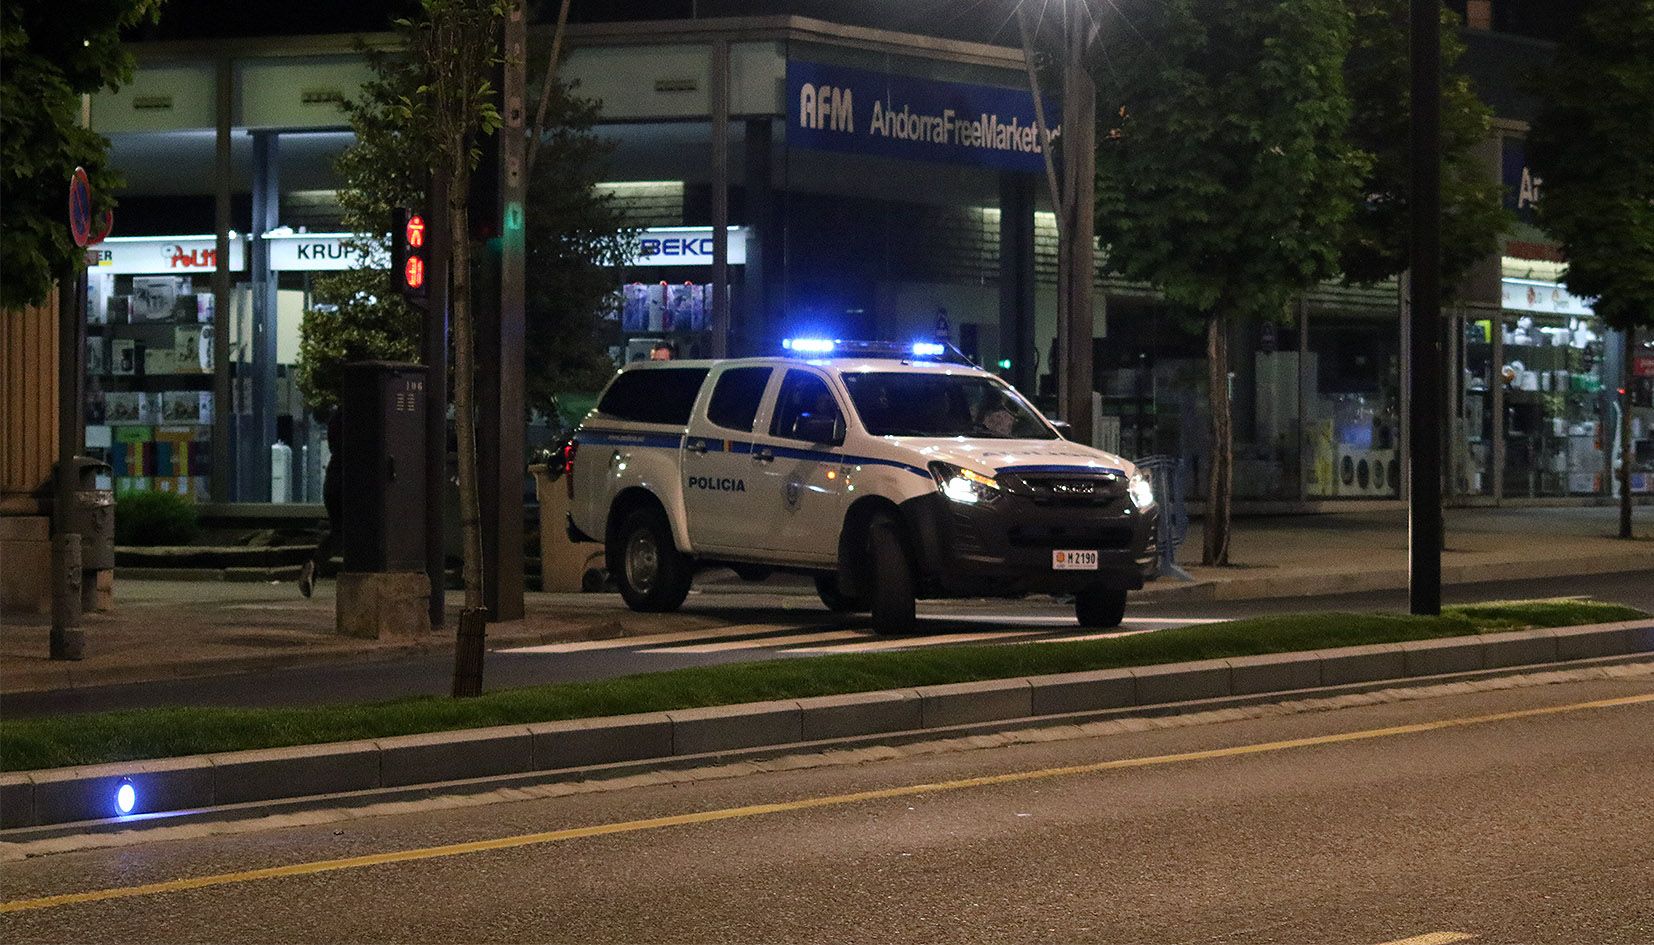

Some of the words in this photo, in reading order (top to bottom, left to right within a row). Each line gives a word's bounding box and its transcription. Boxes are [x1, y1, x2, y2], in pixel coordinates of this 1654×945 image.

[800, 82, 854, 133] AFM
[688, 477, 746, 492] POLICIA
[1075, 552, 1096, 565] 2190
